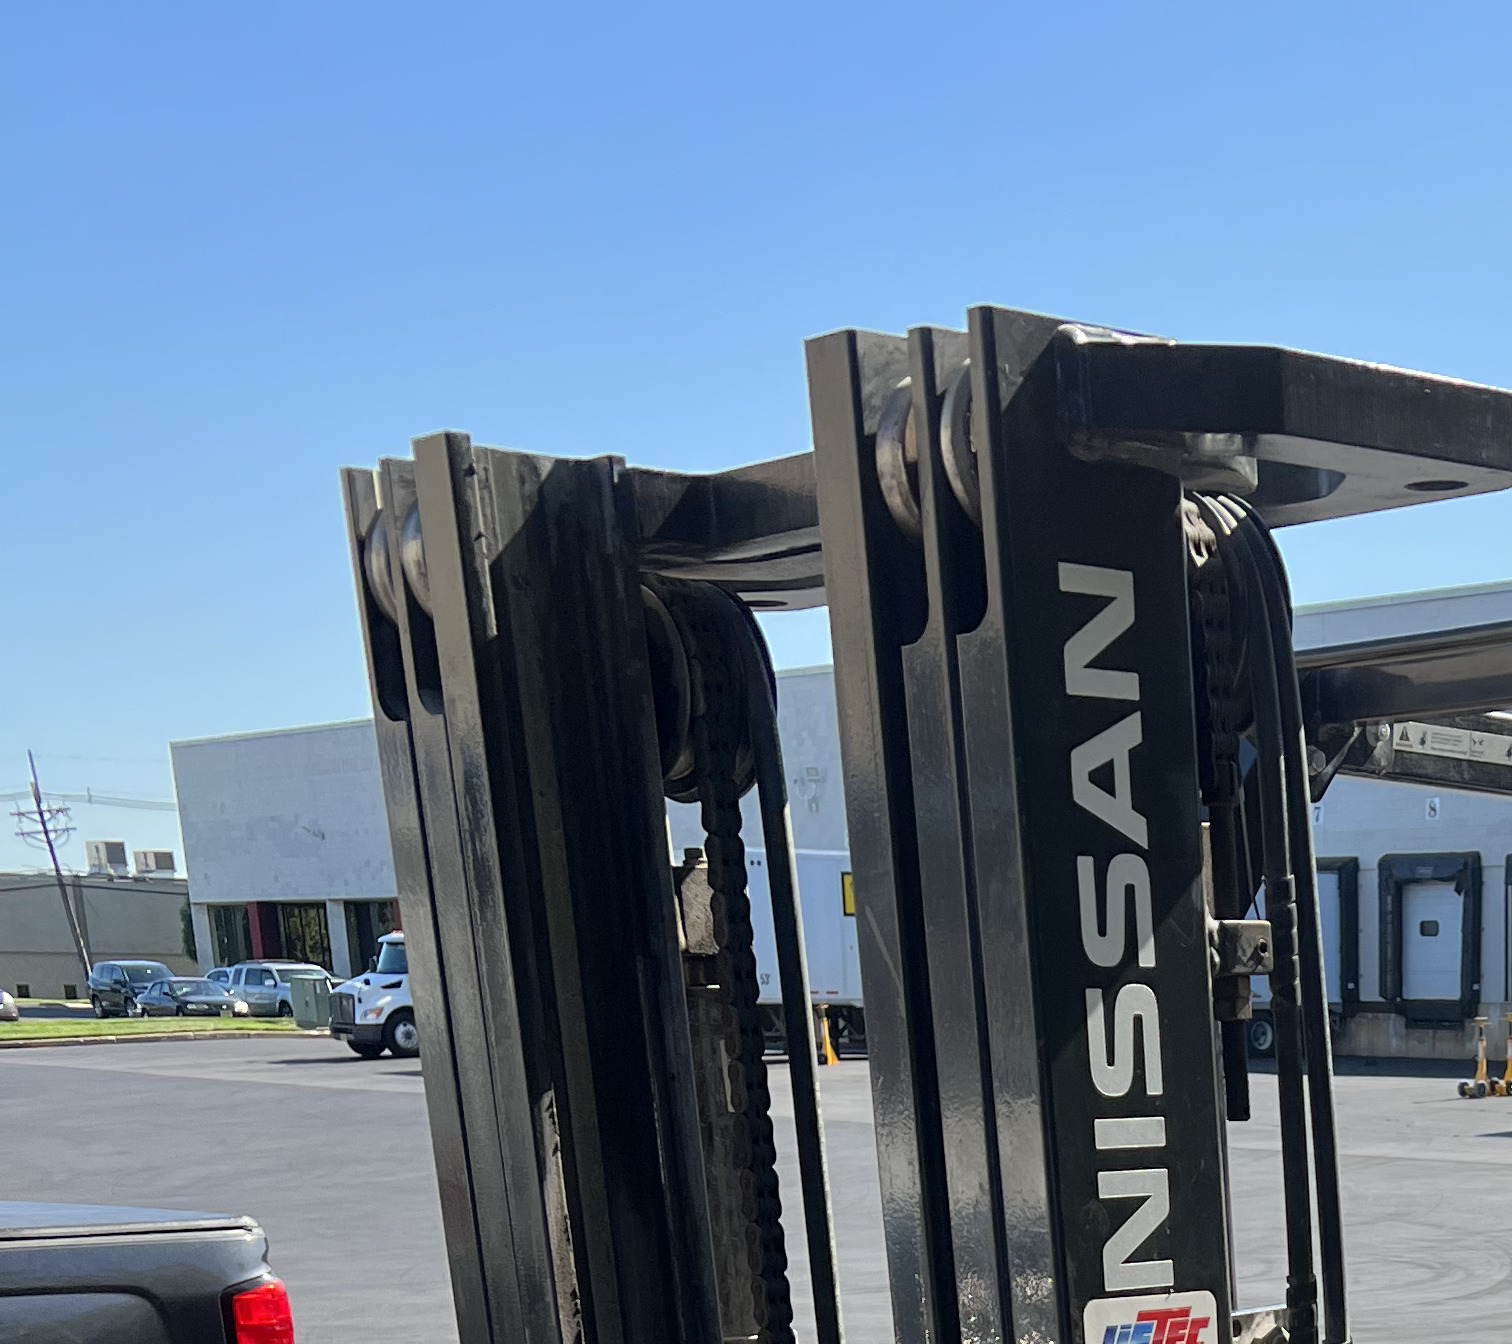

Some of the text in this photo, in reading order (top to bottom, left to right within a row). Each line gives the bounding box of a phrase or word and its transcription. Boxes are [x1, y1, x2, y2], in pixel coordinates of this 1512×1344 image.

[1313, 806, 1321, 823] 7
[1428, 801, 1437, 818] 8
[1057, 561, 1174, 1292] NISSAN
